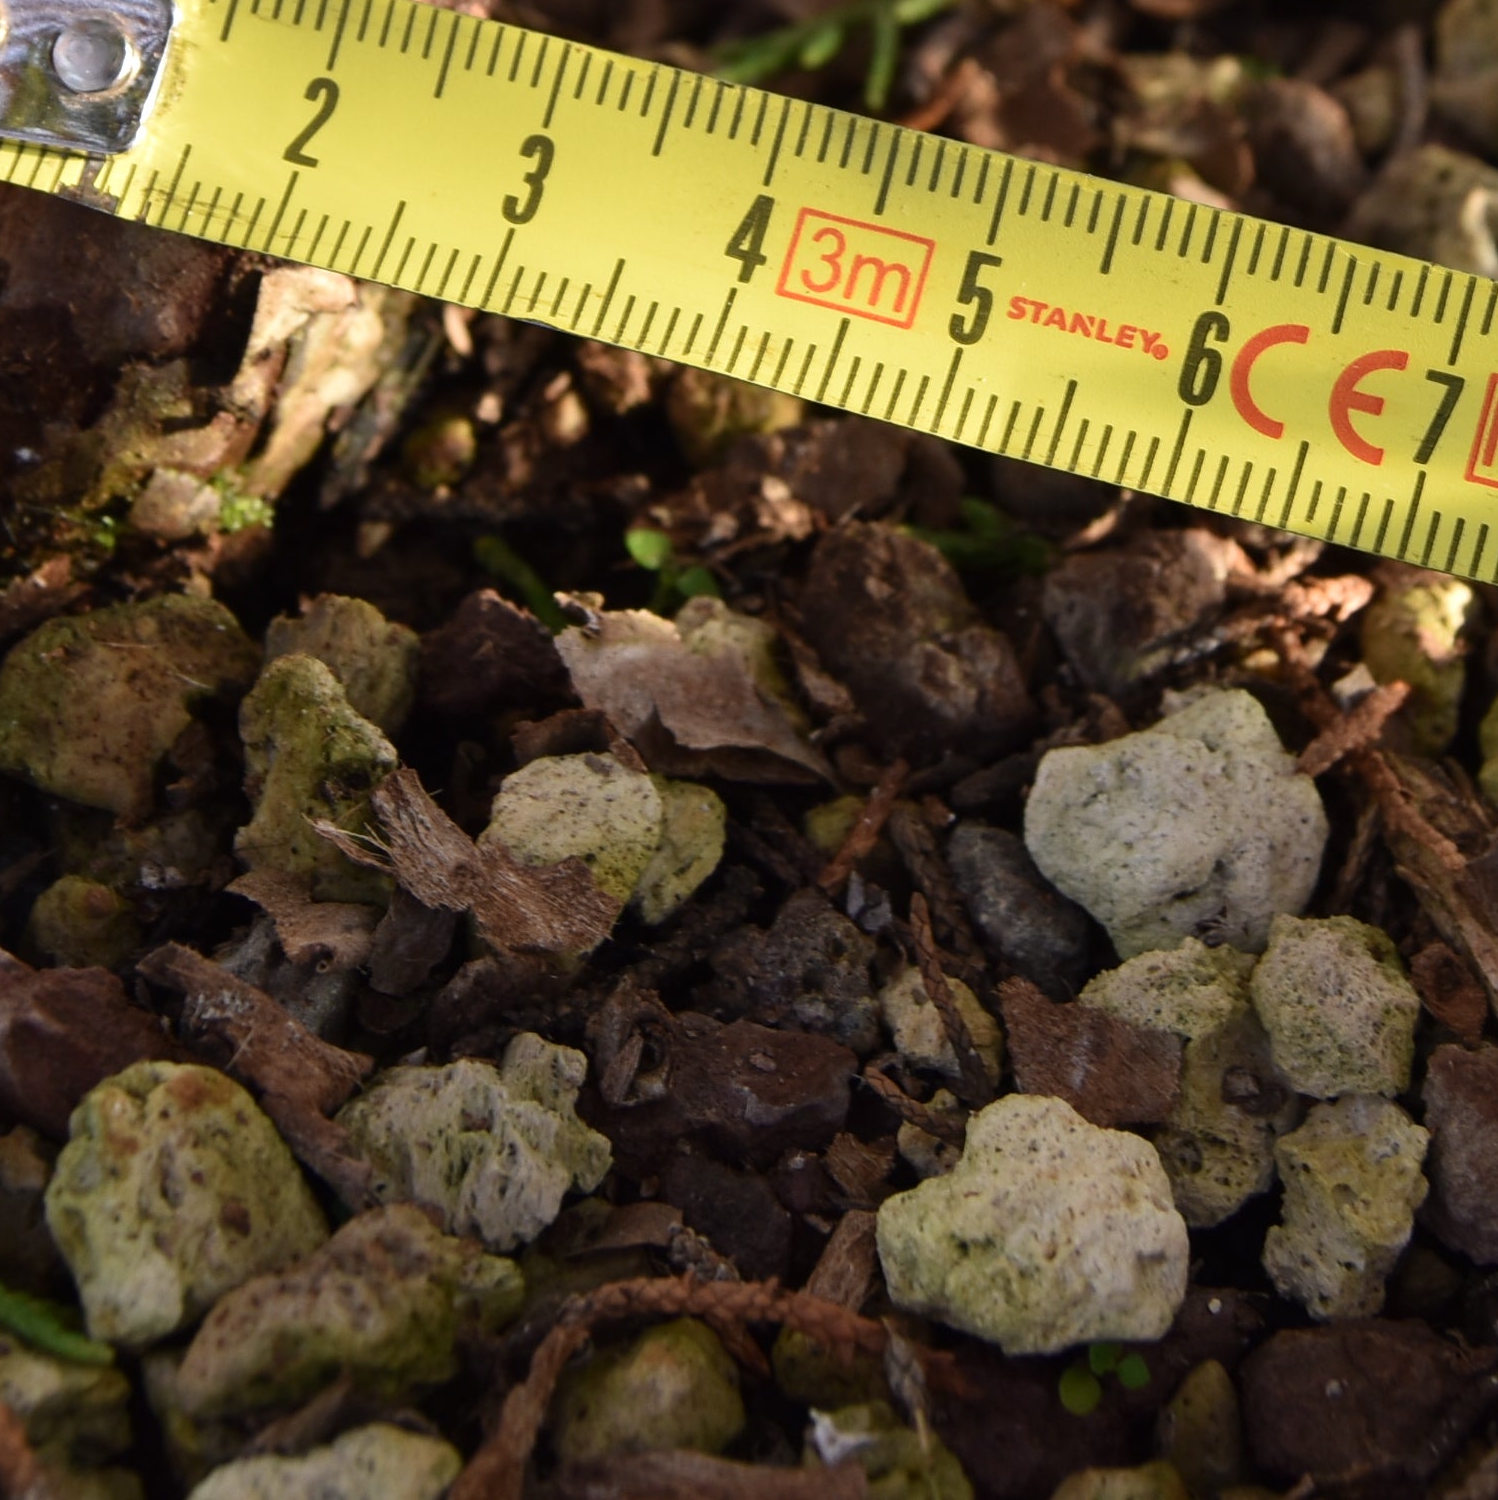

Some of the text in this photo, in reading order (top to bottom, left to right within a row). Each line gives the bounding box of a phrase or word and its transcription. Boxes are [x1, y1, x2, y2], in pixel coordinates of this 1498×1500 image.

[283, 77, 340, 167] 2
[502, 134, 557, 225] 3
[724, 195, 774, 283] 4
[799, 228, 915, 317] 3m
[948, 250, 1003, 346] 5
[1178, 311, 1225, 407] 6
[1413, 369, 1466, 464] 7
